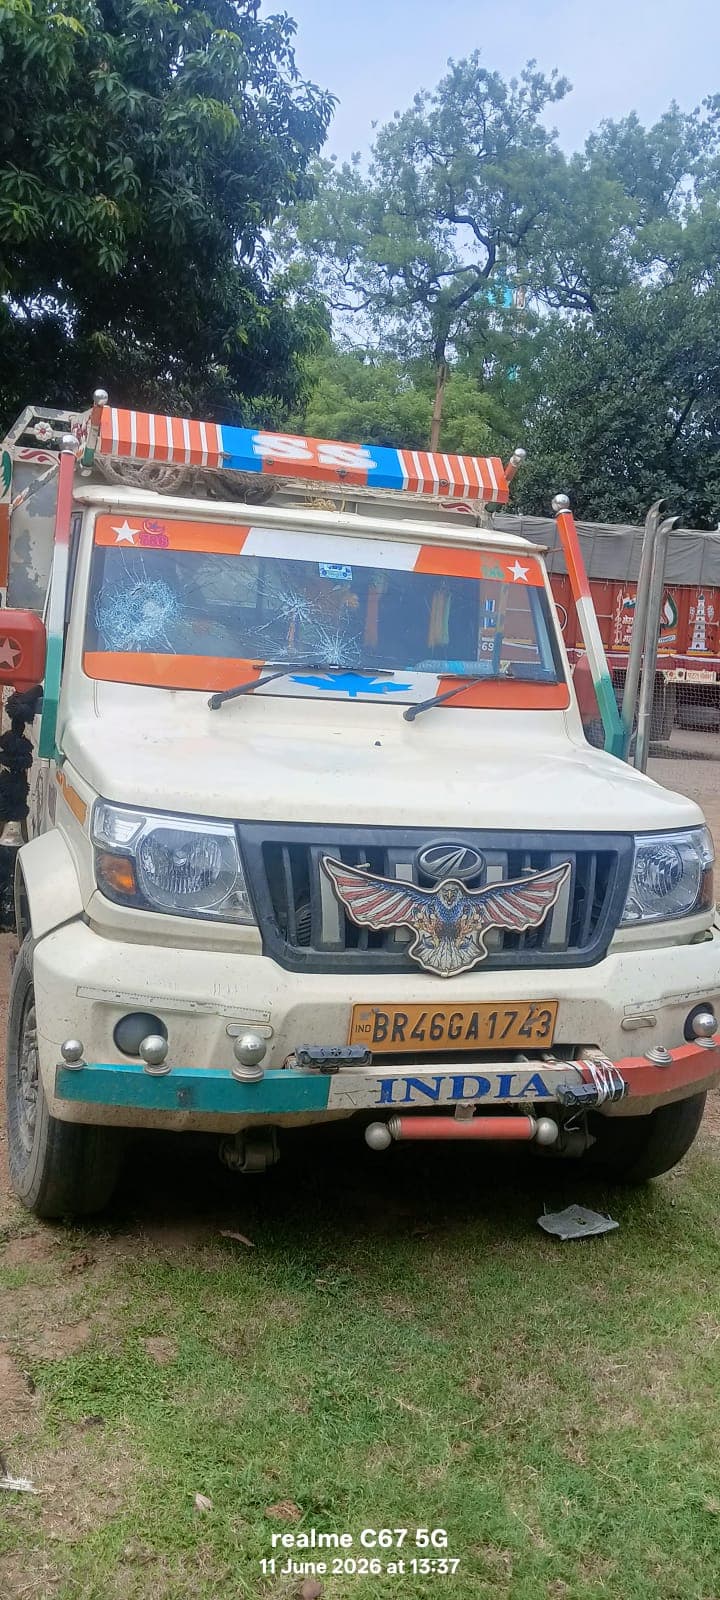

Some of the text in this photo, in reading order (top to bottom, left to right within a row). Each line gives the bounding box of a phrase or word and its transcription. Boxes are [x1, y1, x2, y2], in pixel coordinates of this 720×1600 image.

[251, 434, 378, 469] SS
[355, 1009, 553, 1043] IND BR46GA1743
[375, 1073, 553, 1103] INDIA
